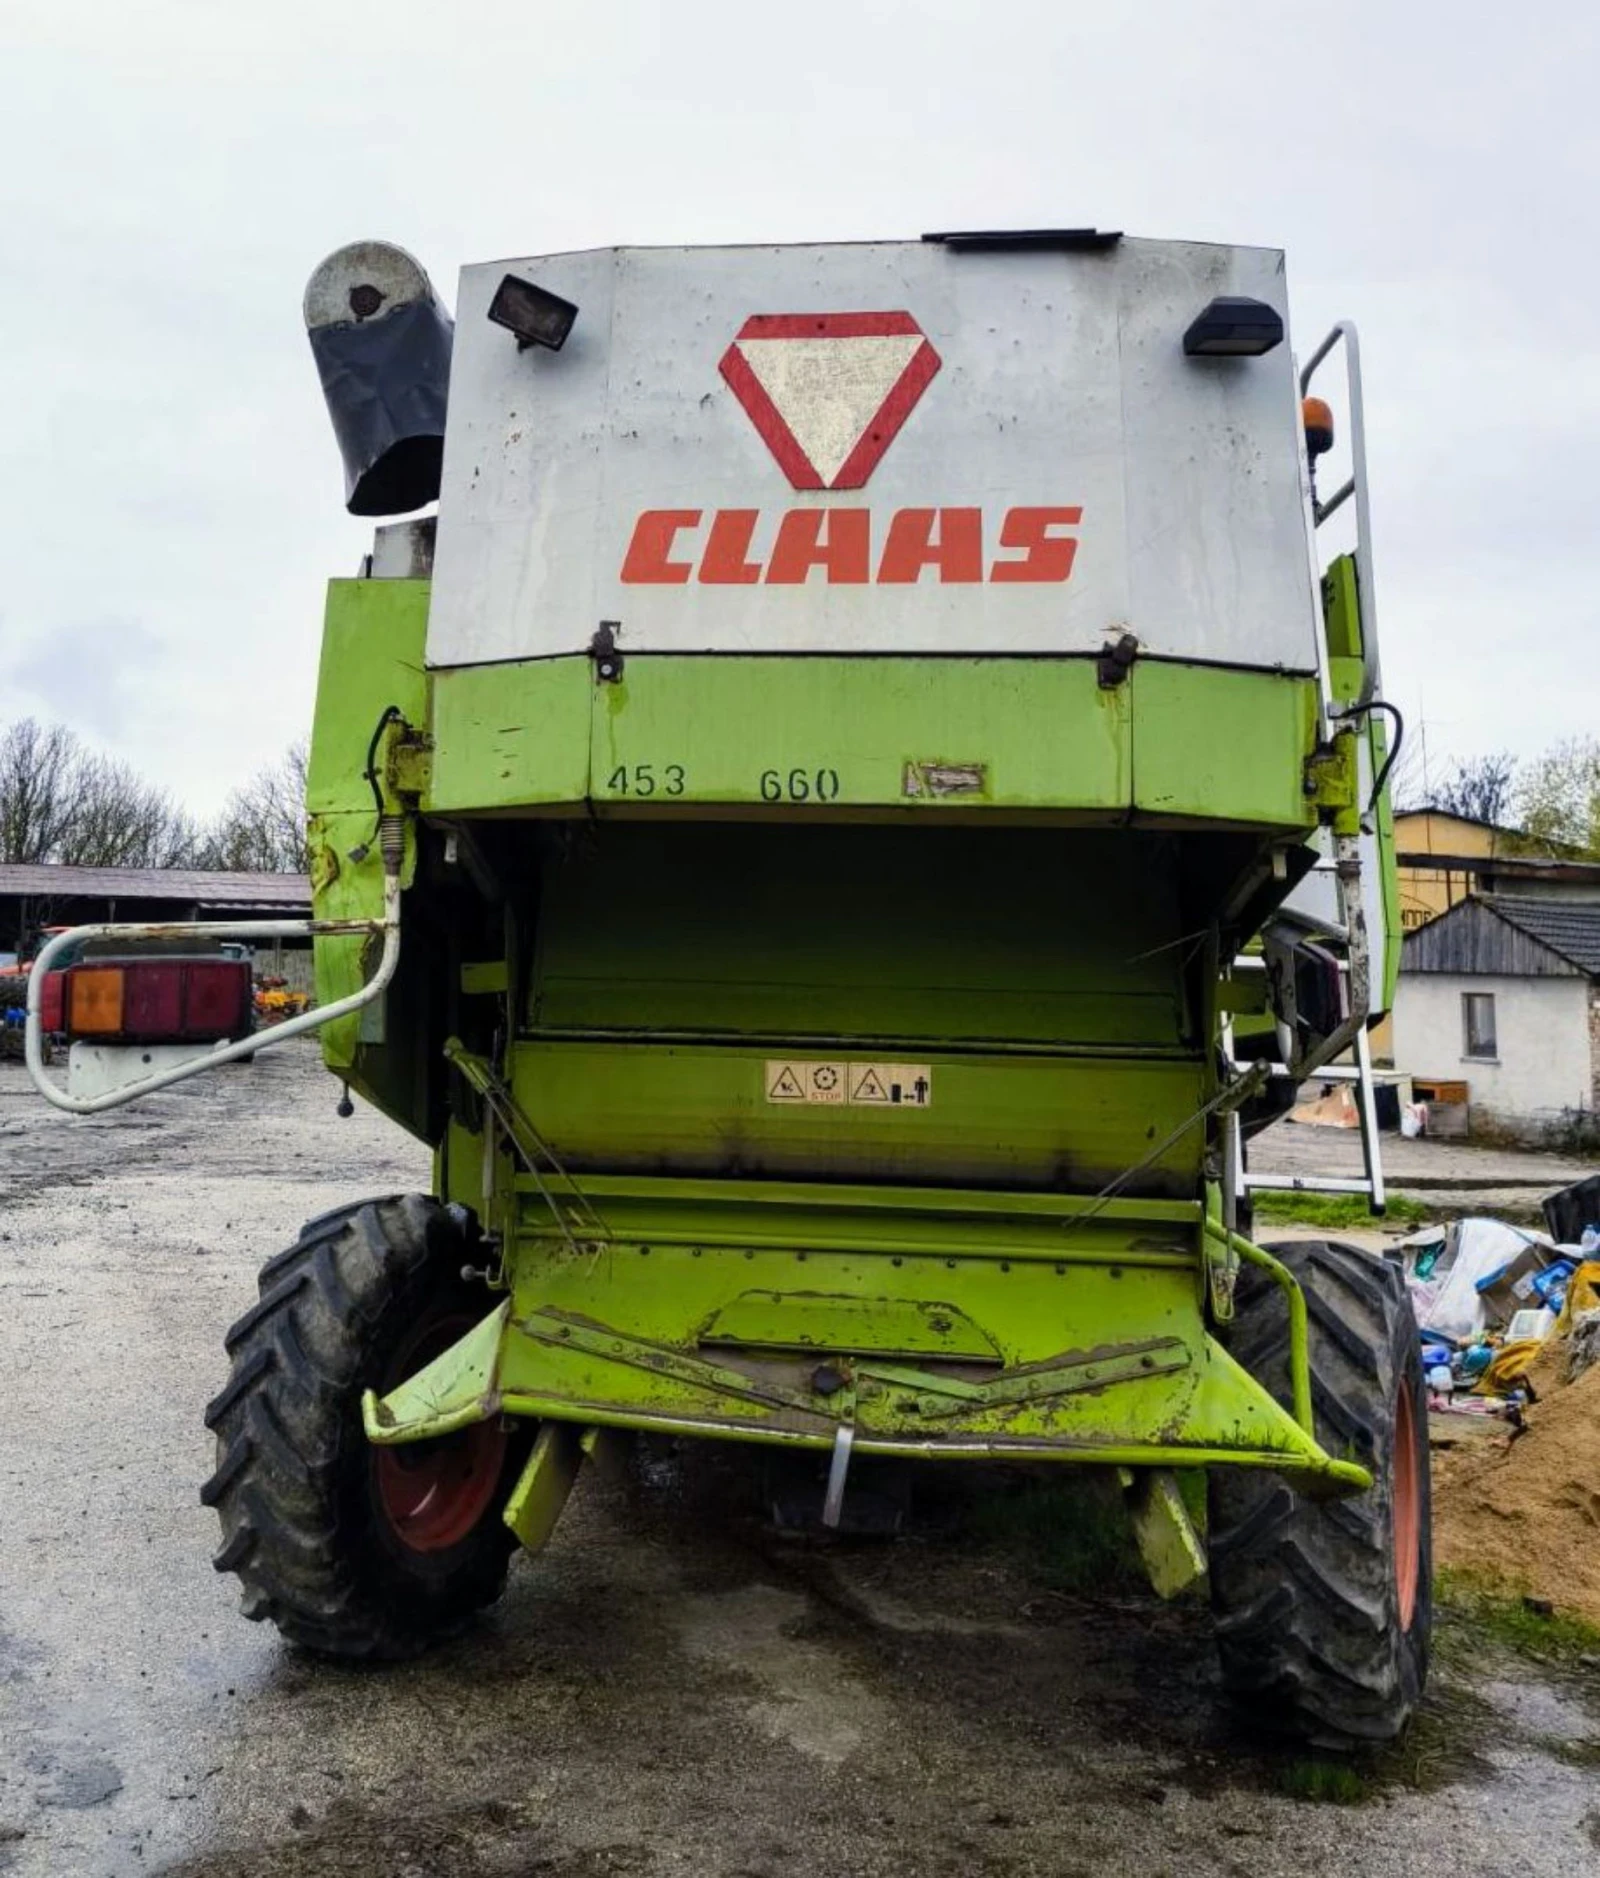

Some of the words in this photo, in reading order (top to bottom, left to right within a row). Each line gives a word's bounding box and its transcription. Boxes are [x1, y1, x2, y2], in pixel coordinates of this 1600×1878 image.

[620, 506, 1083, 585] CLAAS
[607, 764, 686, 797] 453
[760, 768, 840, 802] 660
[811, 1091, 841, 1101] STOP
